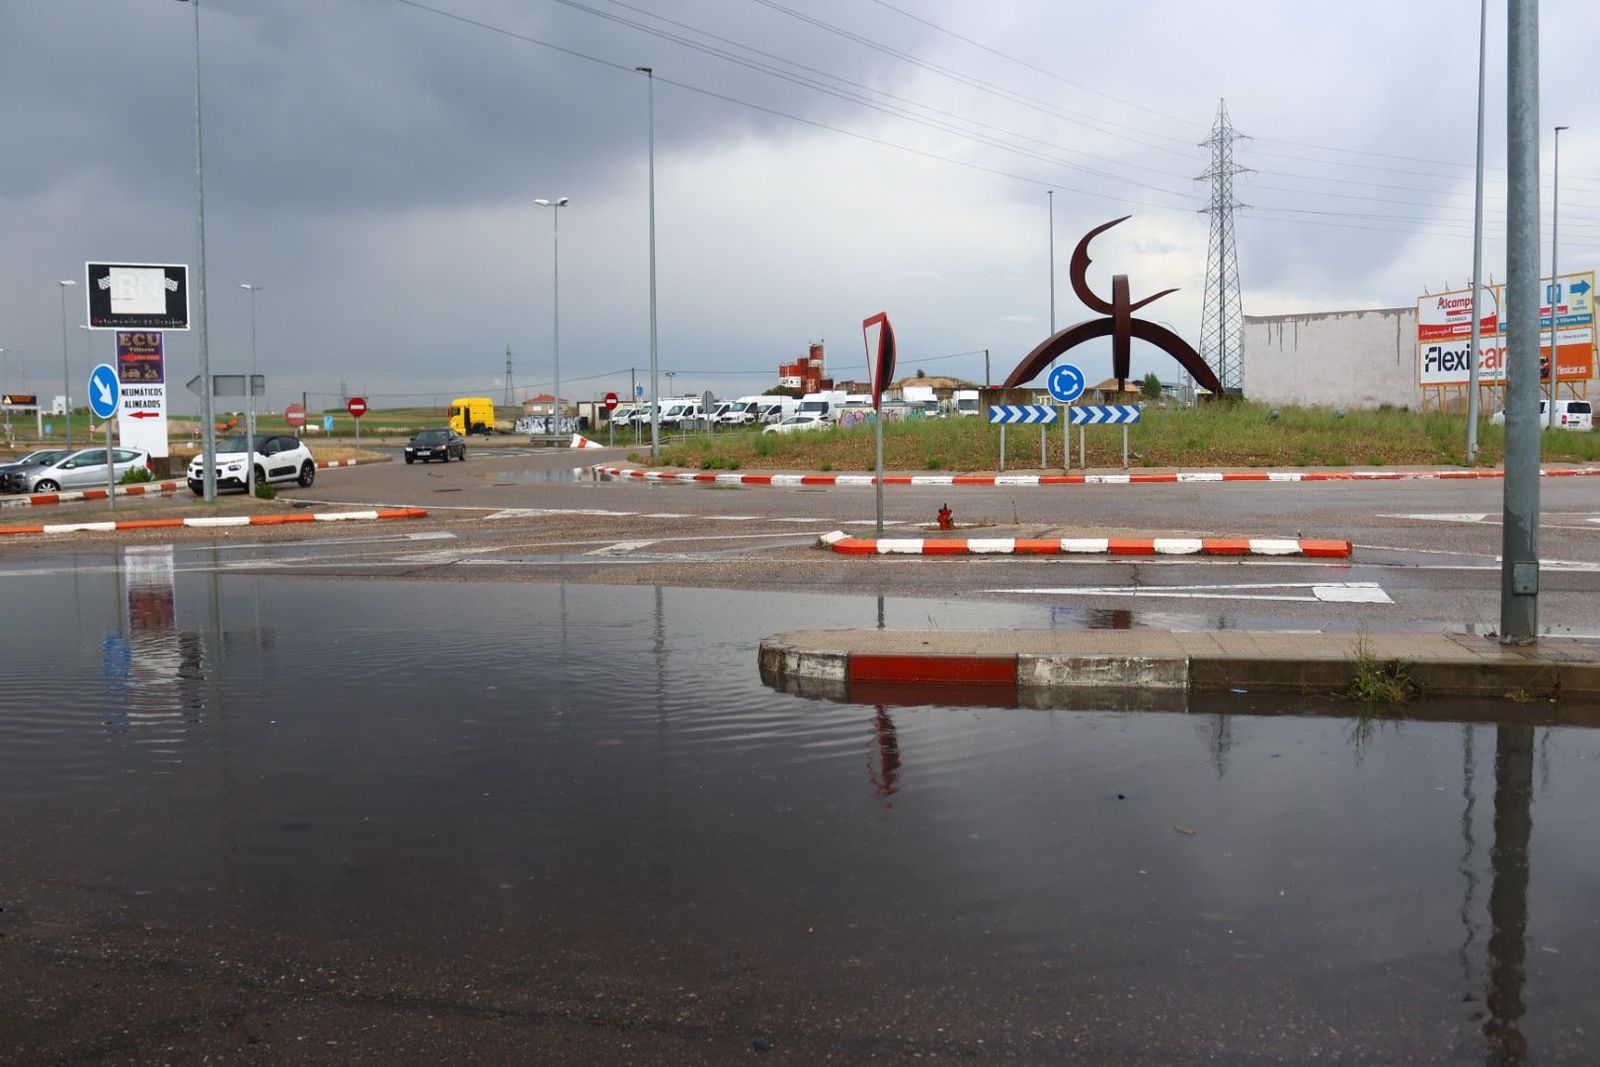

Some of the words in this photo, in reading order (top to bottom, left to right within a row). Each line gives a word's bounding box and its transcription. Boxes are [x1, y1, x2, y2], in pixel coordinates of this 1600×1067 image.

[119, 333, 161, 347] ECU
[121, 386, 163, 397] NEUMÁTICOS
[124, 399, 161, 409] ALINEADOS
